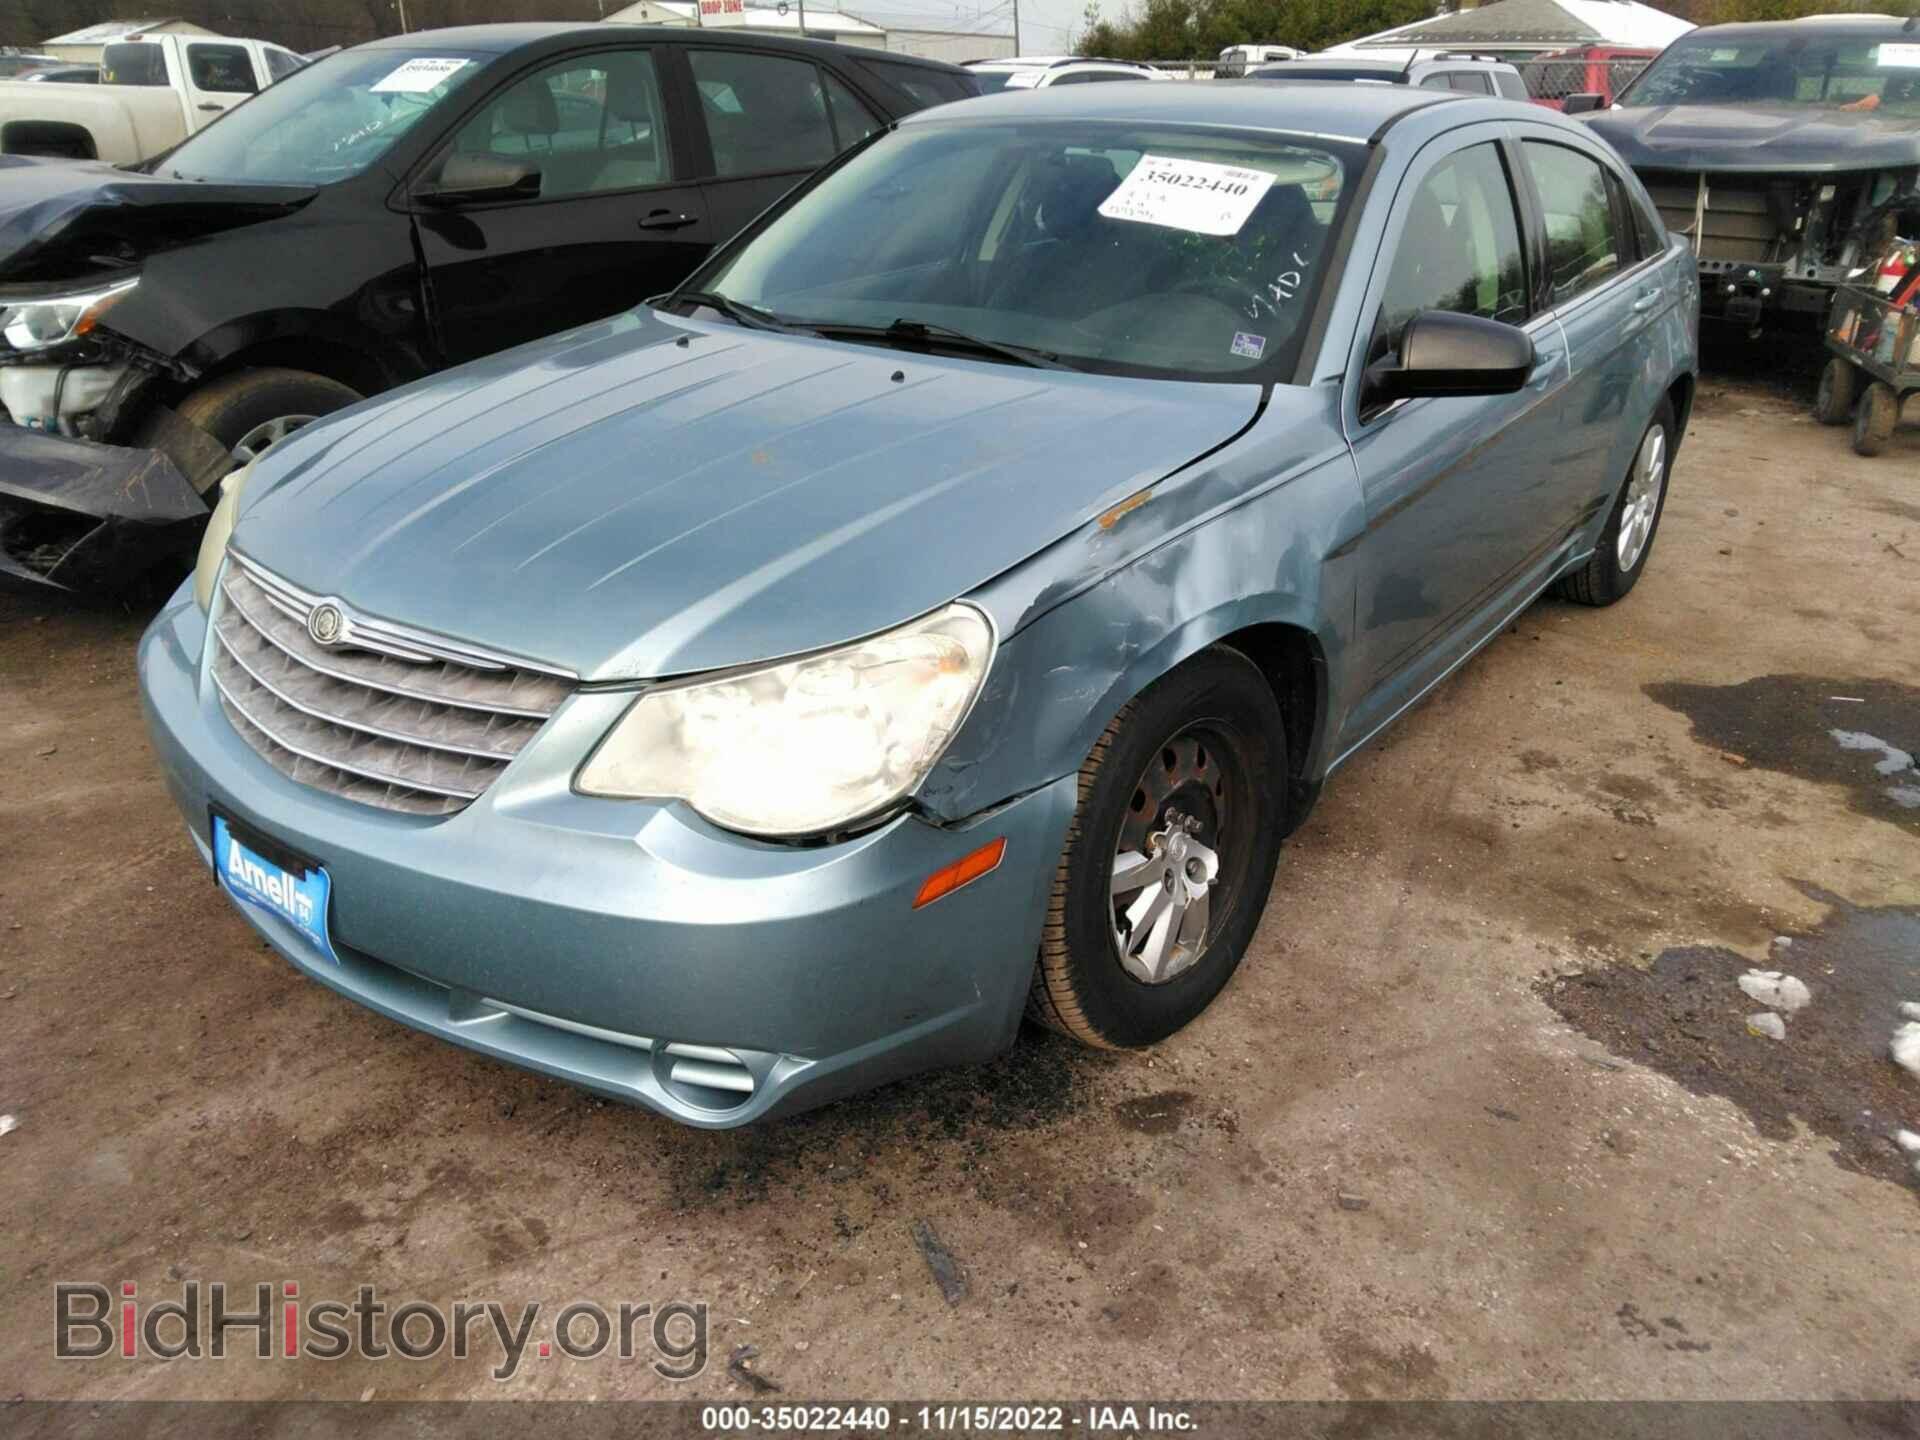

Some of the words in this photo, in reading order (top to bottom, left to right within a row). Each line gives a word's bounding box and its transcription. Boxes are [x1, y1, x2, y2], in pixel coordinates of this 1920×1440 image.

[701, 1, 721, 15] DROP
[724, 0, 743, 13] ZONE
[1139, 170, 1249, 197] 35022440
